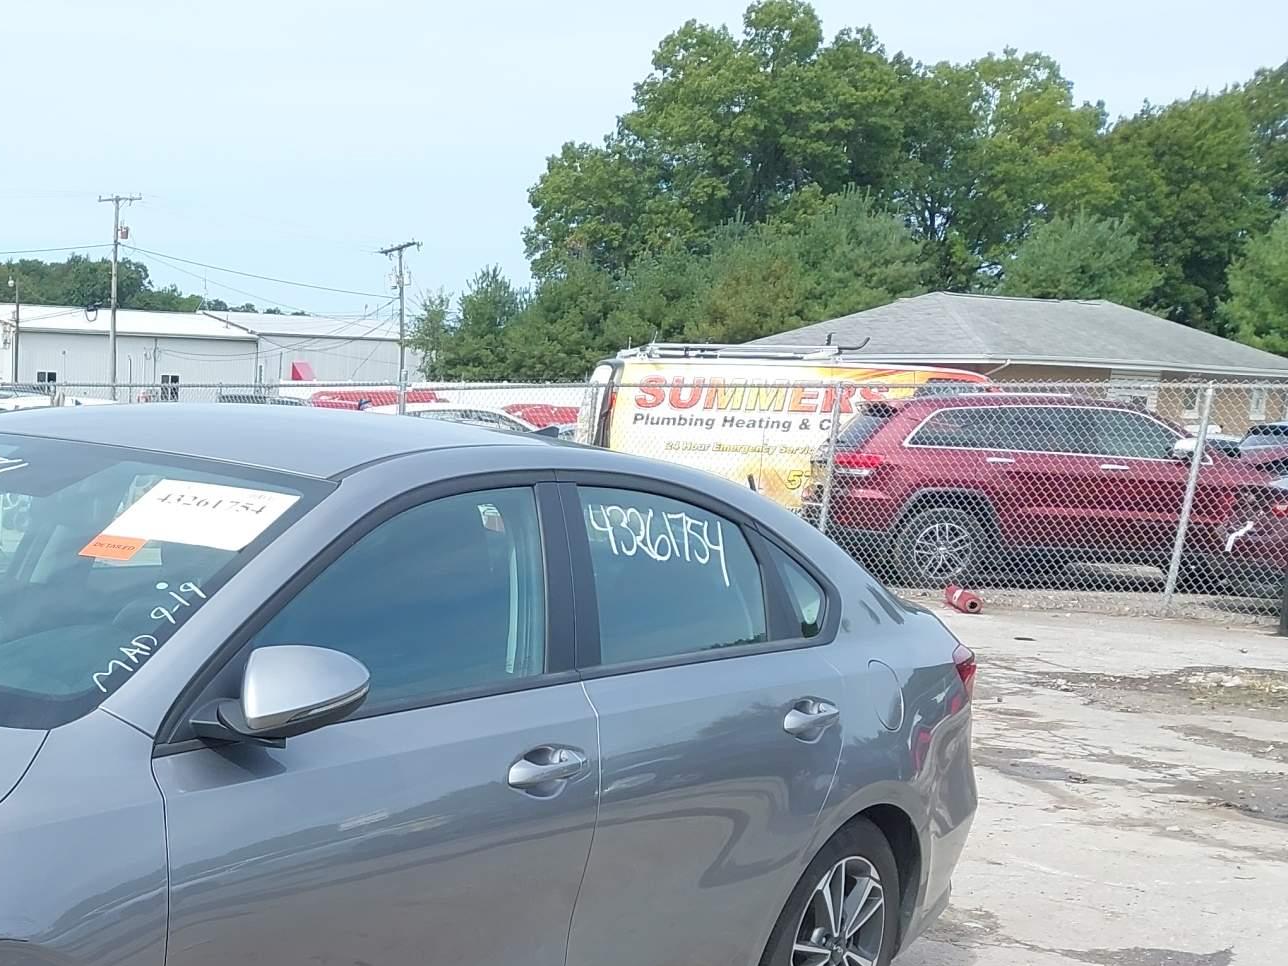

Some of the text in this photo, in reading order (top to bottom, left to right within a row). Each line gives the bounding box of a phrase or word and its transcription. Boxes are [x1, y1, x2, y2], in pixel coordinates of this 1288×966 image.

[634, 375, 890, 413] SUMMERS
[632, 413, 716, 430] Plumbing
[721, 415, 792, 432] Heating
[798, 418, 811, 430] &
[664, 441, 680, 451] 24
[682, 441, 711, 452] Hour
[712, 442, 776, 455] Emergency
[156, 493, 267, 515] 43261754
[588, 504, 730, 587] 43261754
[92, 581, 207, 692] MAD 9-19
